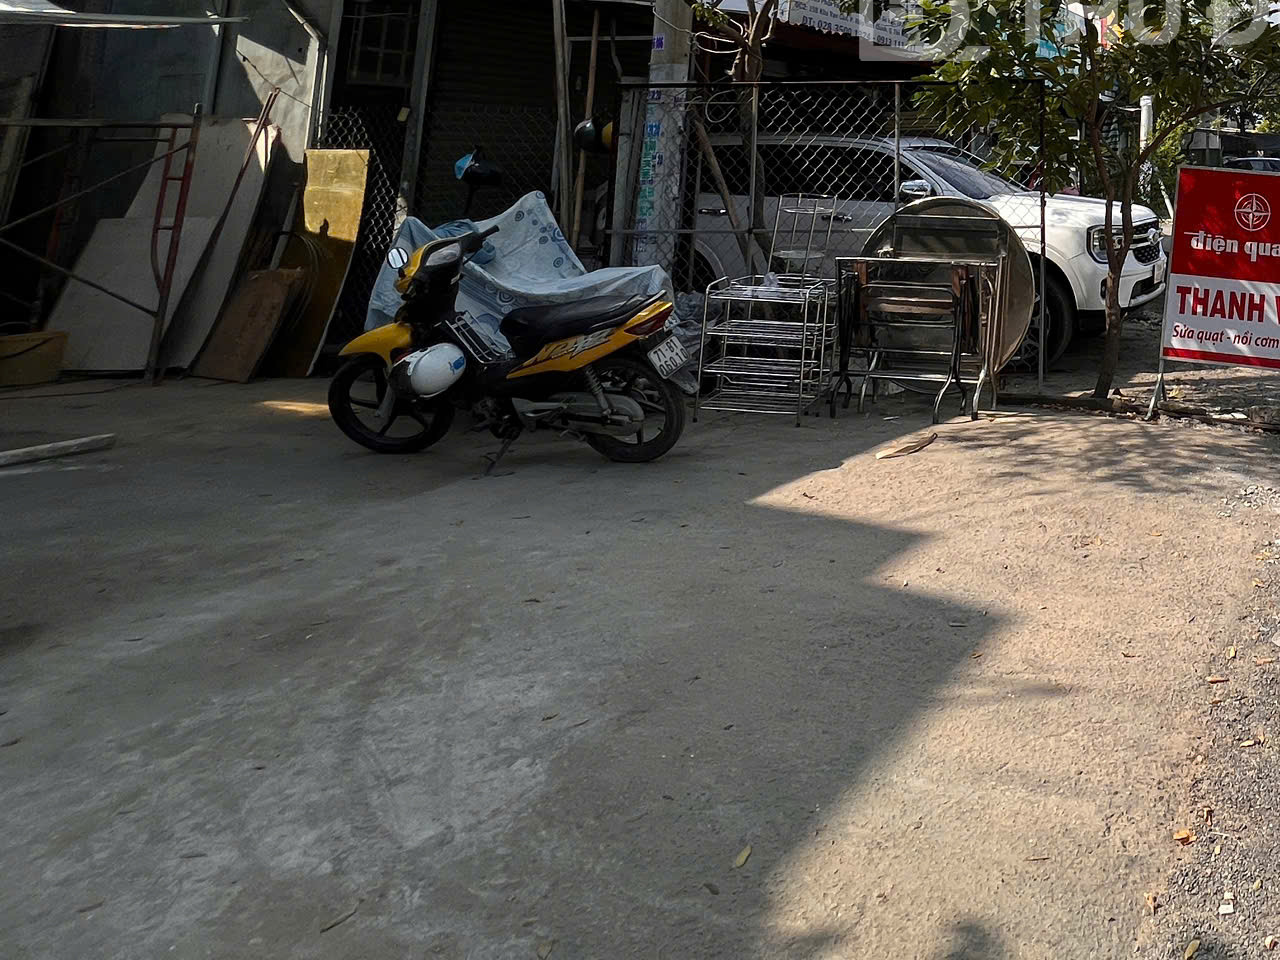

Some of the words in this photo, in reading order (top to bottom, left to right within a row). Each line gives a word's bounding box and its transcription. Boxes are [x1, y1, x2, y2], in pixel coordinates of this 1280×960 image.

[1184, 230, 1238, 254] điện
[1176, 285, 1266, 323] THANH
[1172, 324, 1194, 340] Sửa
[1197, 329, 1224, 346] quạt
[1233, 330, 1252, 345] nồi
[1254, 337, 1279, 349] cơm
